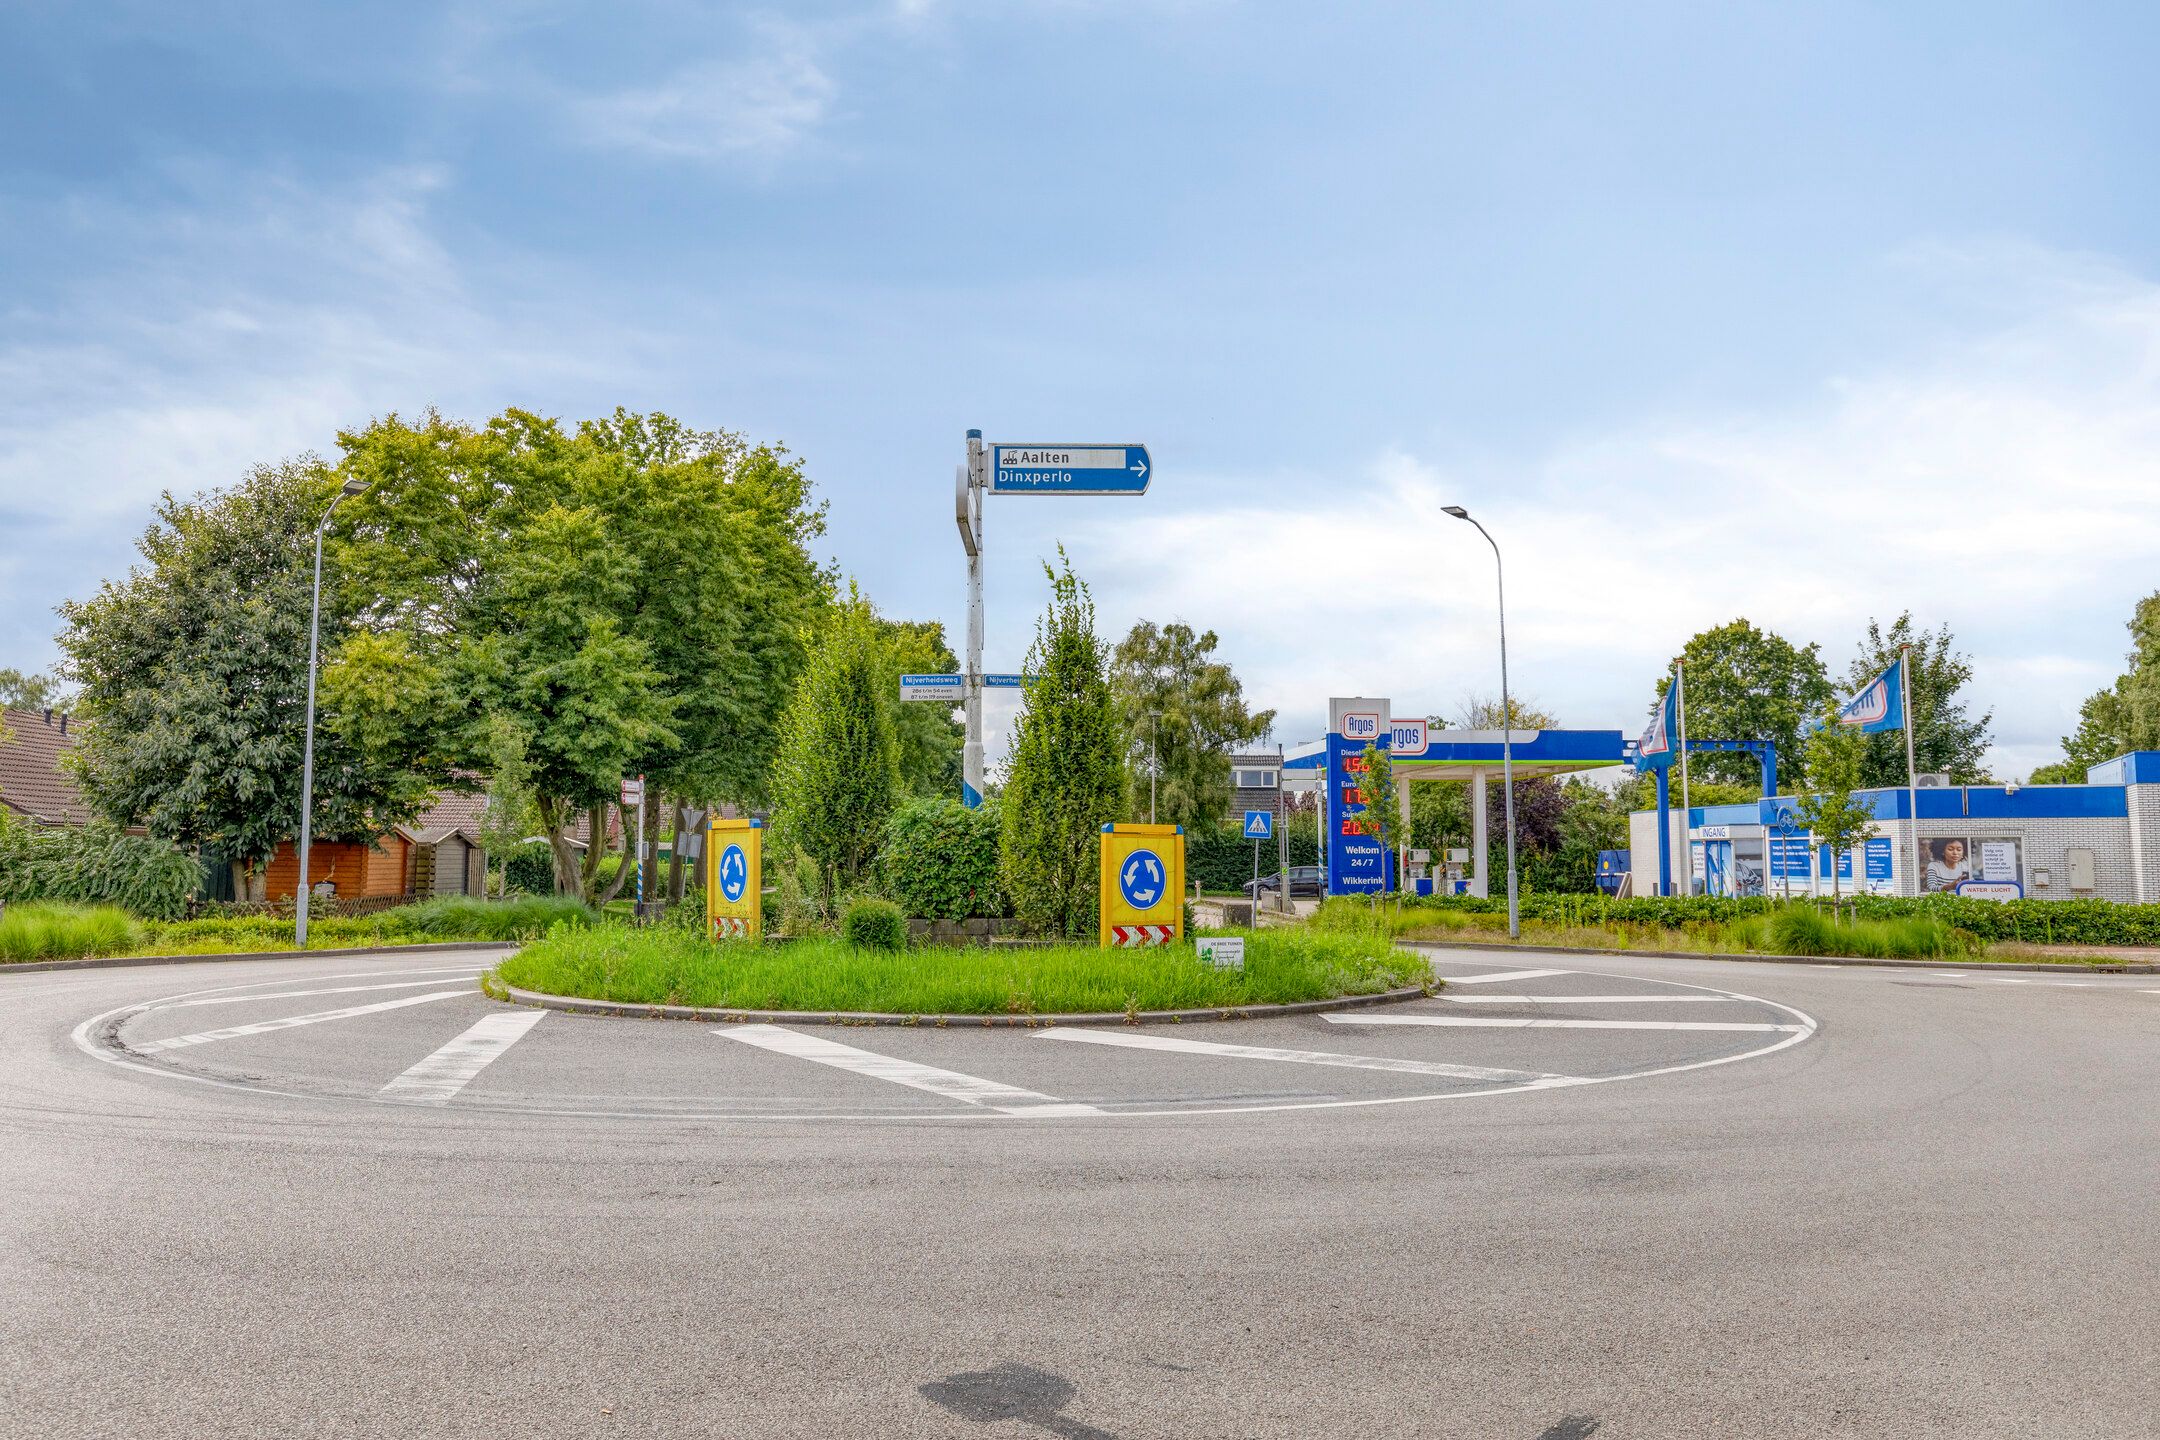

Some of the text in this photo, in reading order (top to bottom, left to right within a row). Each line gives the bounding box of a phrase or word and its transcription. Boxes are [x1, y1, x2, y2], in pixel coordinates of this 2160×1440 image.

[1021, 451, 1069, 464] Aalten
[999, 470, 1072, 485] Dinxperlo
[905, 677, 958, 685] Nijverheidsweg
[1348, 716, 1374, 735] Argos
[1391, 726, 1419, 748] rgos
[1702, 828, 1726, 837] INGANG
[1345, 846, 1379, 854] Welkom
[1351, 859, 1374, 867] 24/7
[1342, 877, 1384, 885] Wikkerink
